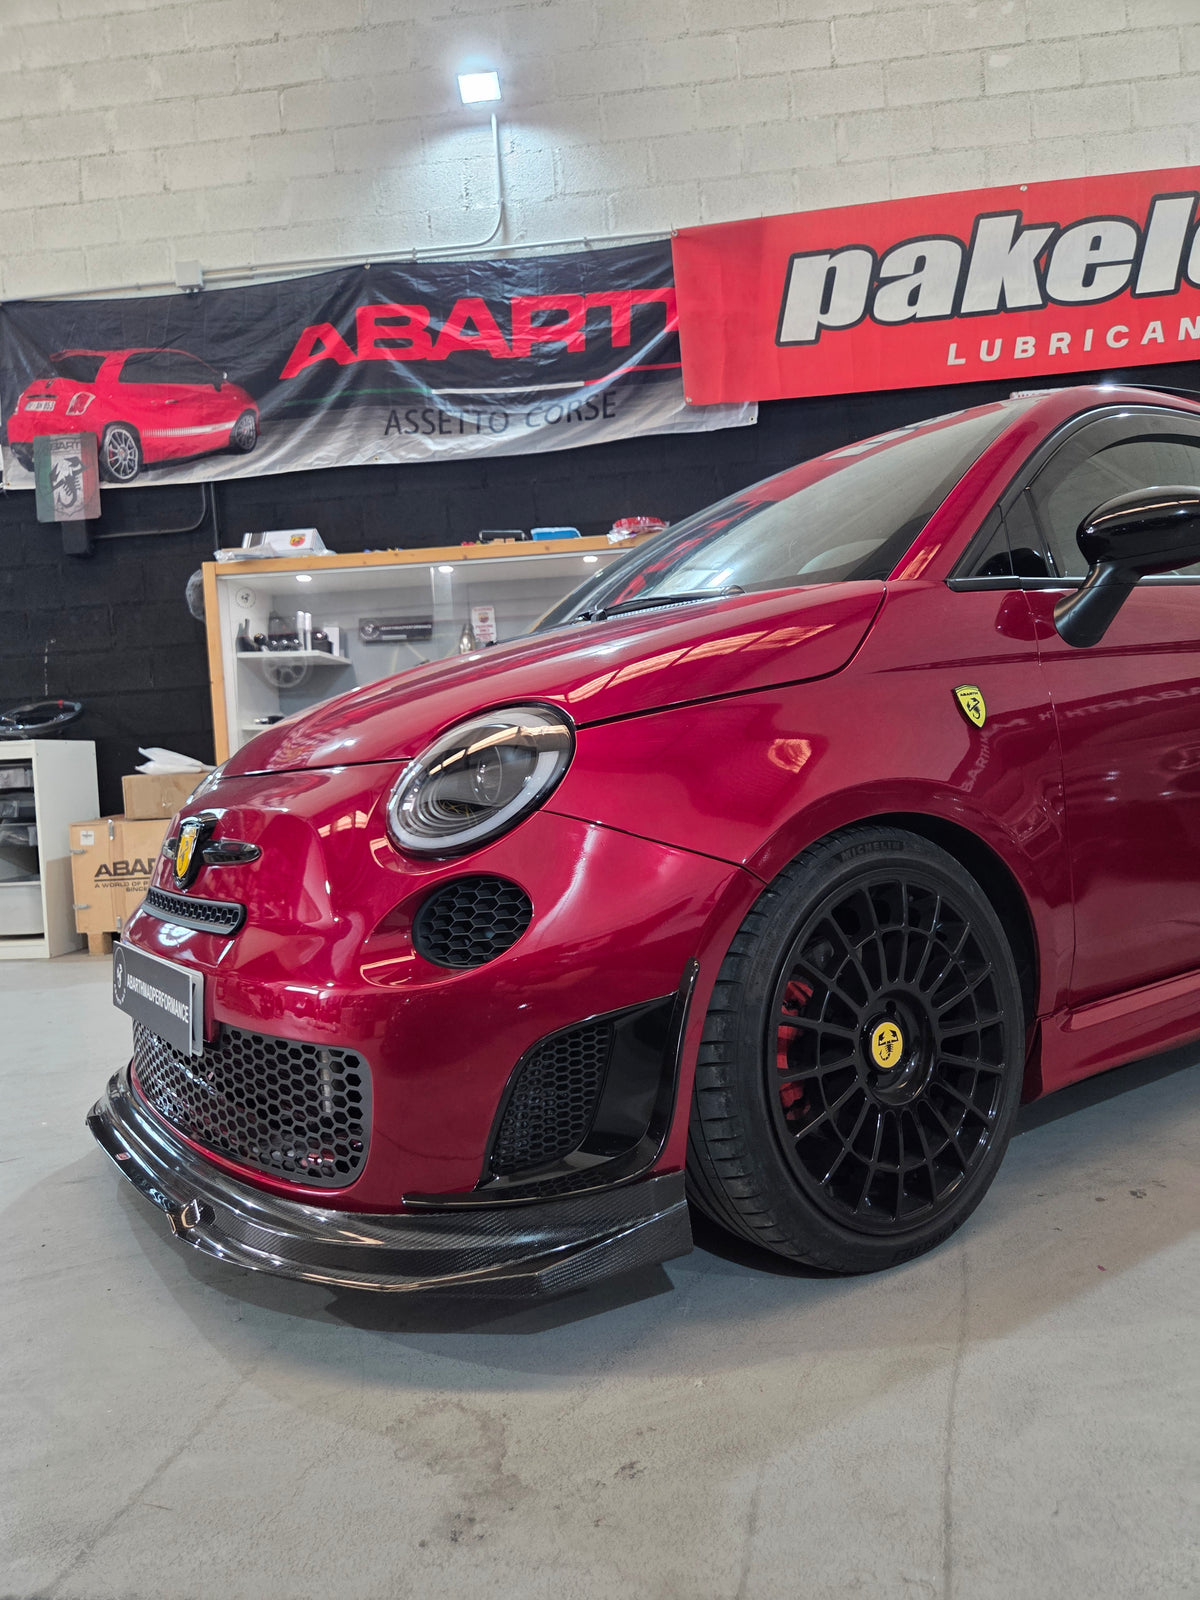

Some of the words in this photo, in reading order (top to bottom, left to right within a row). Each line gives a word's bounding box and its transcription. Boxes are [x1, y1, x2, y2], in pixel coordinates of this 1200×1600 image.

[776, 191, 1200, 346] pakel
[384, 408, 509, 436] ASSETTO
[525, 391, 617, 428] CORSE
[840, 841, 901, 862] MICHELIN
